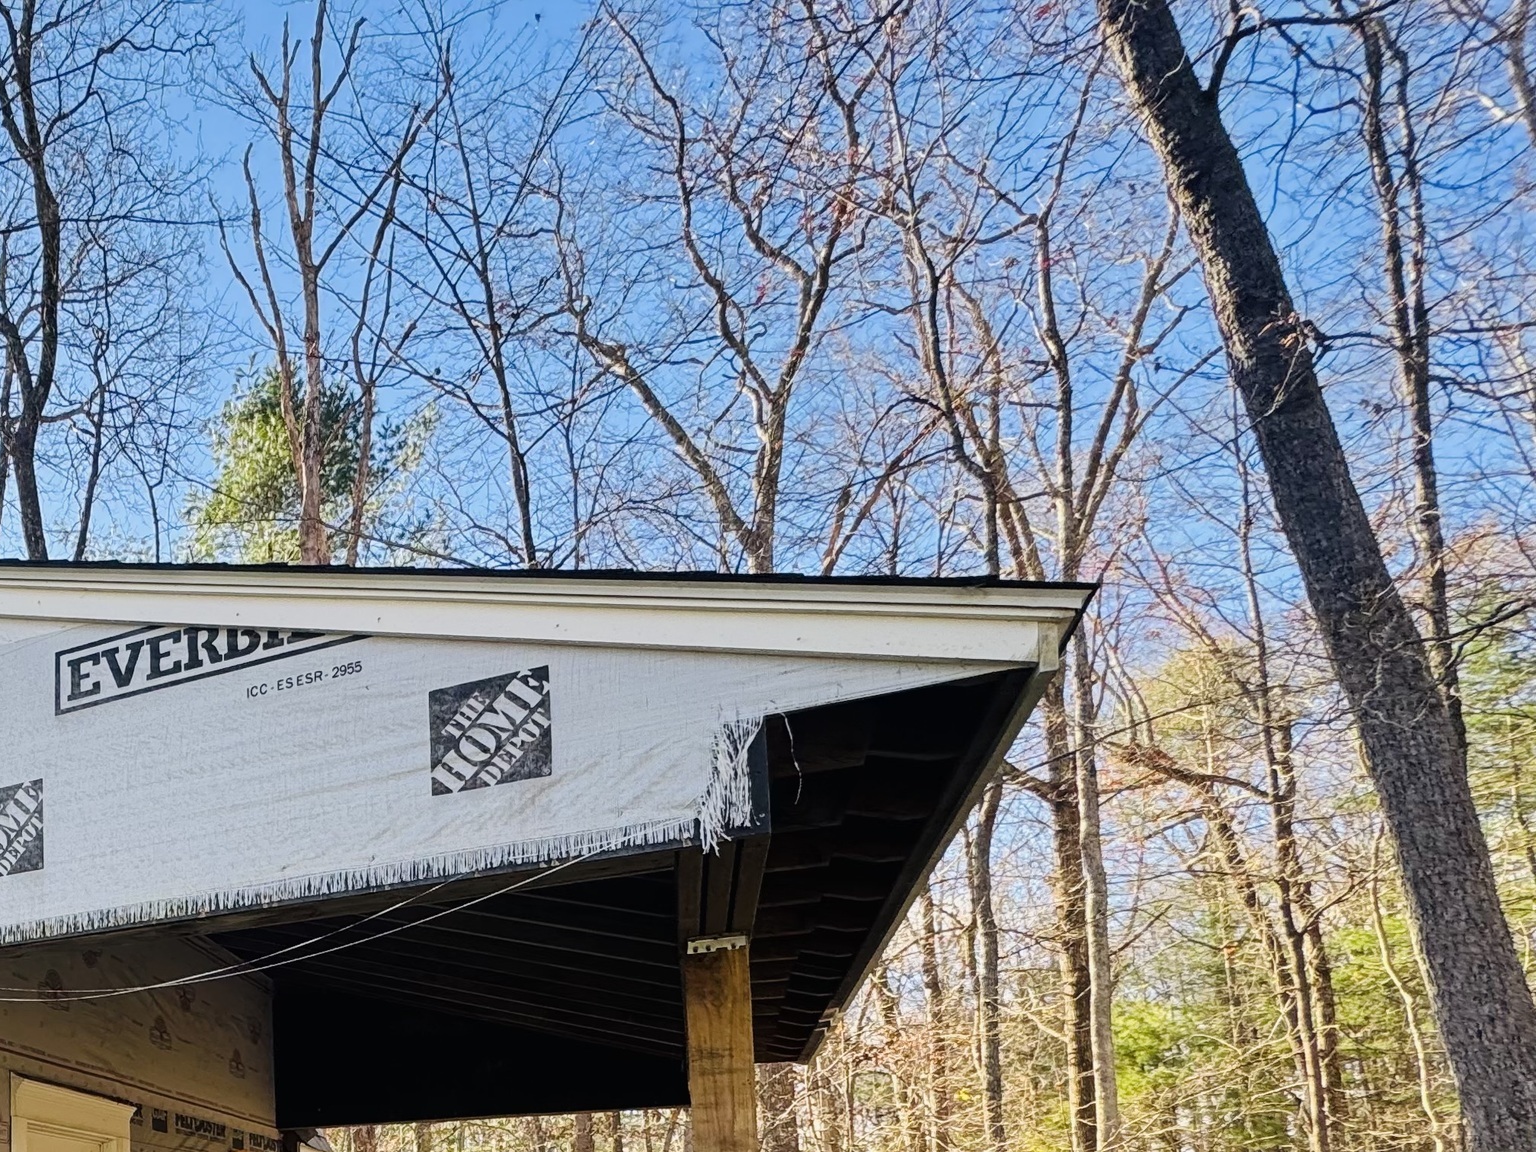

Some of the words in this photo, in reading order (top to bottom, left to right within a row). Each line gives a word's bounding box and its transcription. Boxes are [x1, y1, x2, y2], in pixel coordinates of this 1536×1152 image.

[331, 660, 363, 680] 2955
[430, 669, 550, 793] HOME
[441, 691, 490, 740] THE
[477, 707, 551, 787] DEPOT
